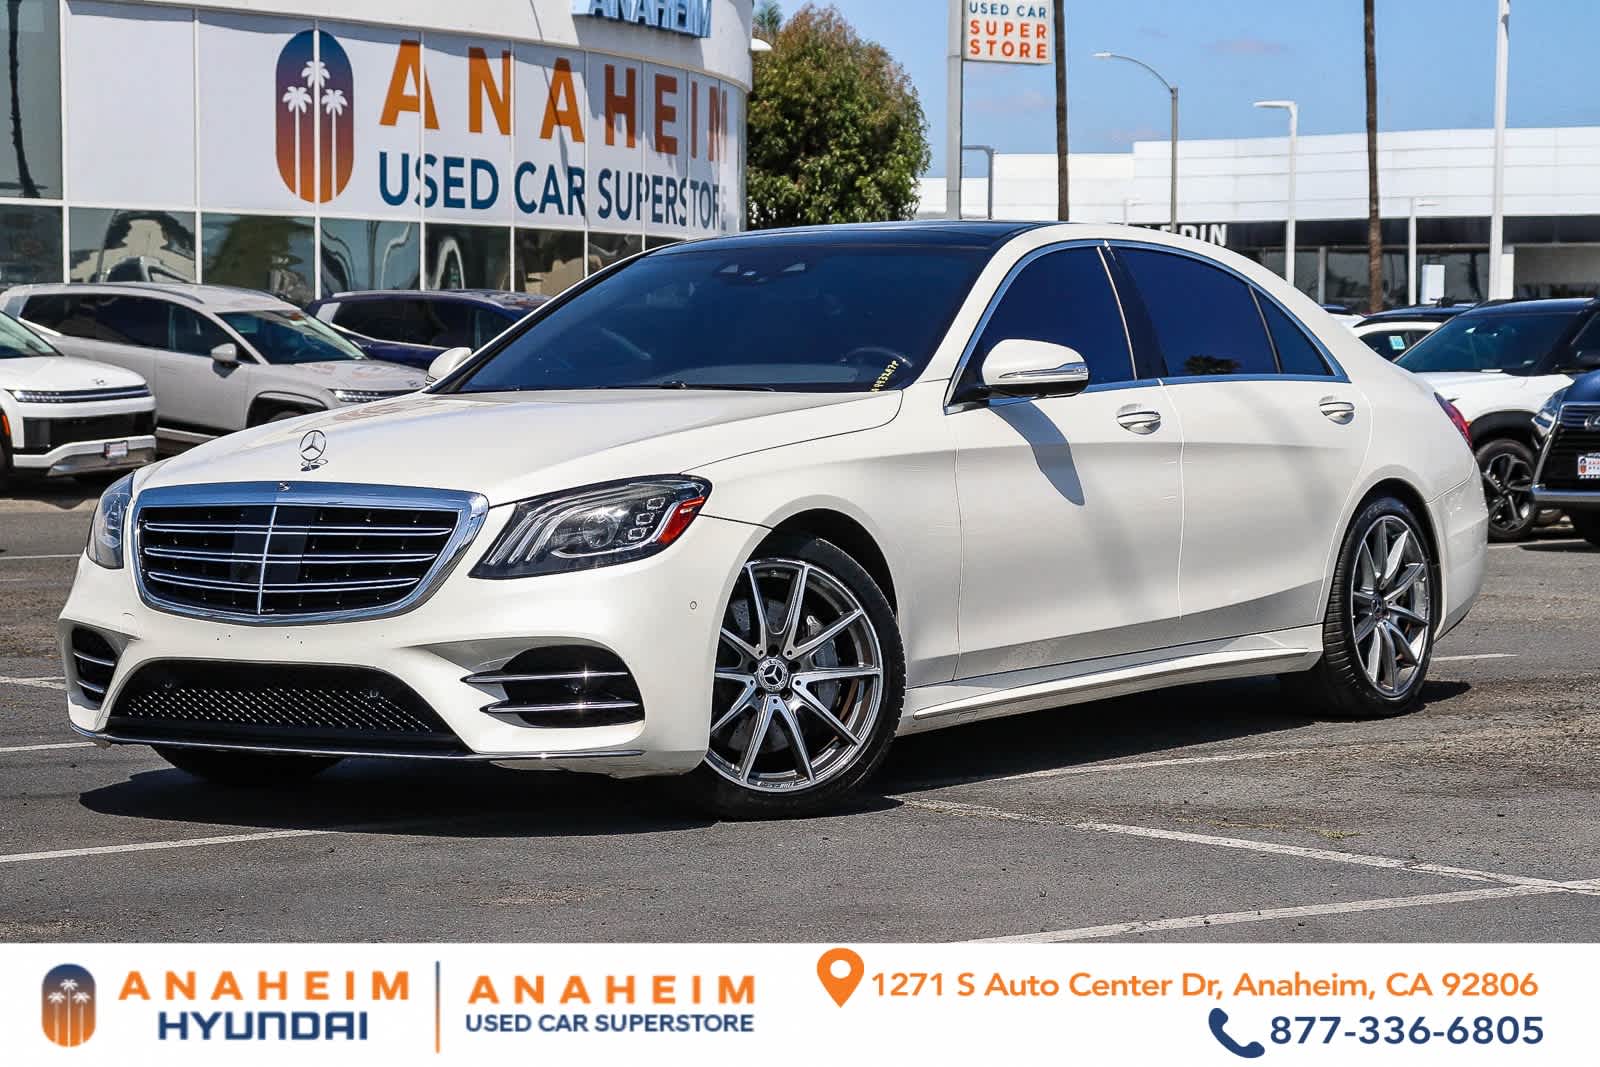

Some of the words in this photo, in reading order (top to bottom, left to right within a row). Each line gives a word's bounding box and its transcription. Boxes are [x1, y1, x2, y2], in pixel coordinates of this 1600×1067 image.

[969, 2, 1009, 16] USED
[1016, 5, 1047, 19] CAR
[970, 19, 1047, 39] SUPER
[970, 38, 1047, 59] STORE
[379, 39, 728, 164] ANAHEIM
[379, 151, 499, 211] USED
[514, 159, 586, 217] CAR
[598, 169, 727, 232] SUPERSTORE
